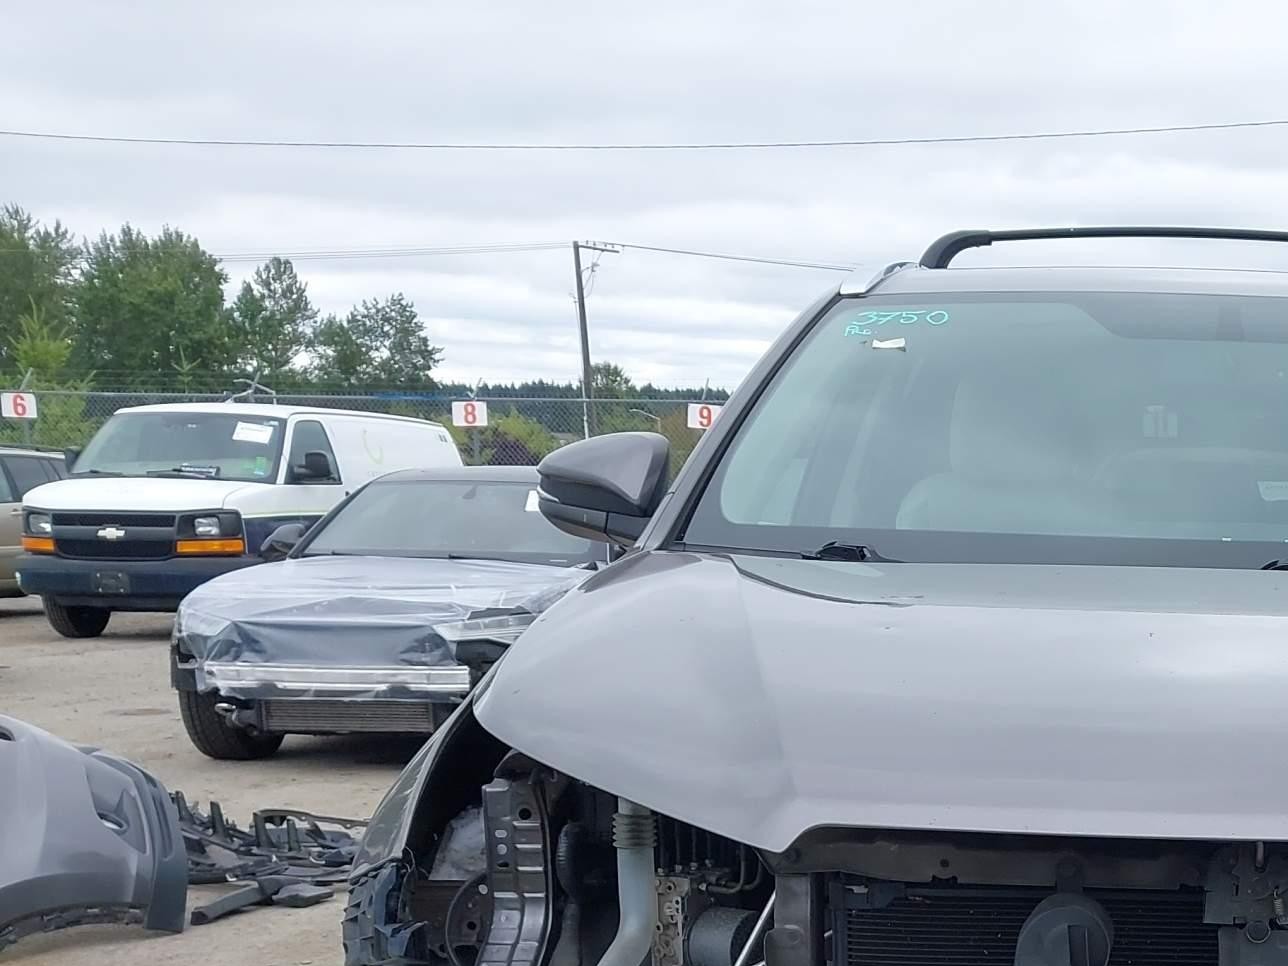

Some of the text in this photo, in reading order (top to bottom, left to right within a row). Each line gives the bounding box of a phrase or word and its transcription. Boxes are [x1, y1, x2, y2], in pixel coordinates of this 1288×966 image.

[852, 310, 949, 325] 3750
[12, 394, 27, 417] 6
[463, 402, 477, 425] 8
[698, 405, 713, 428] 9
